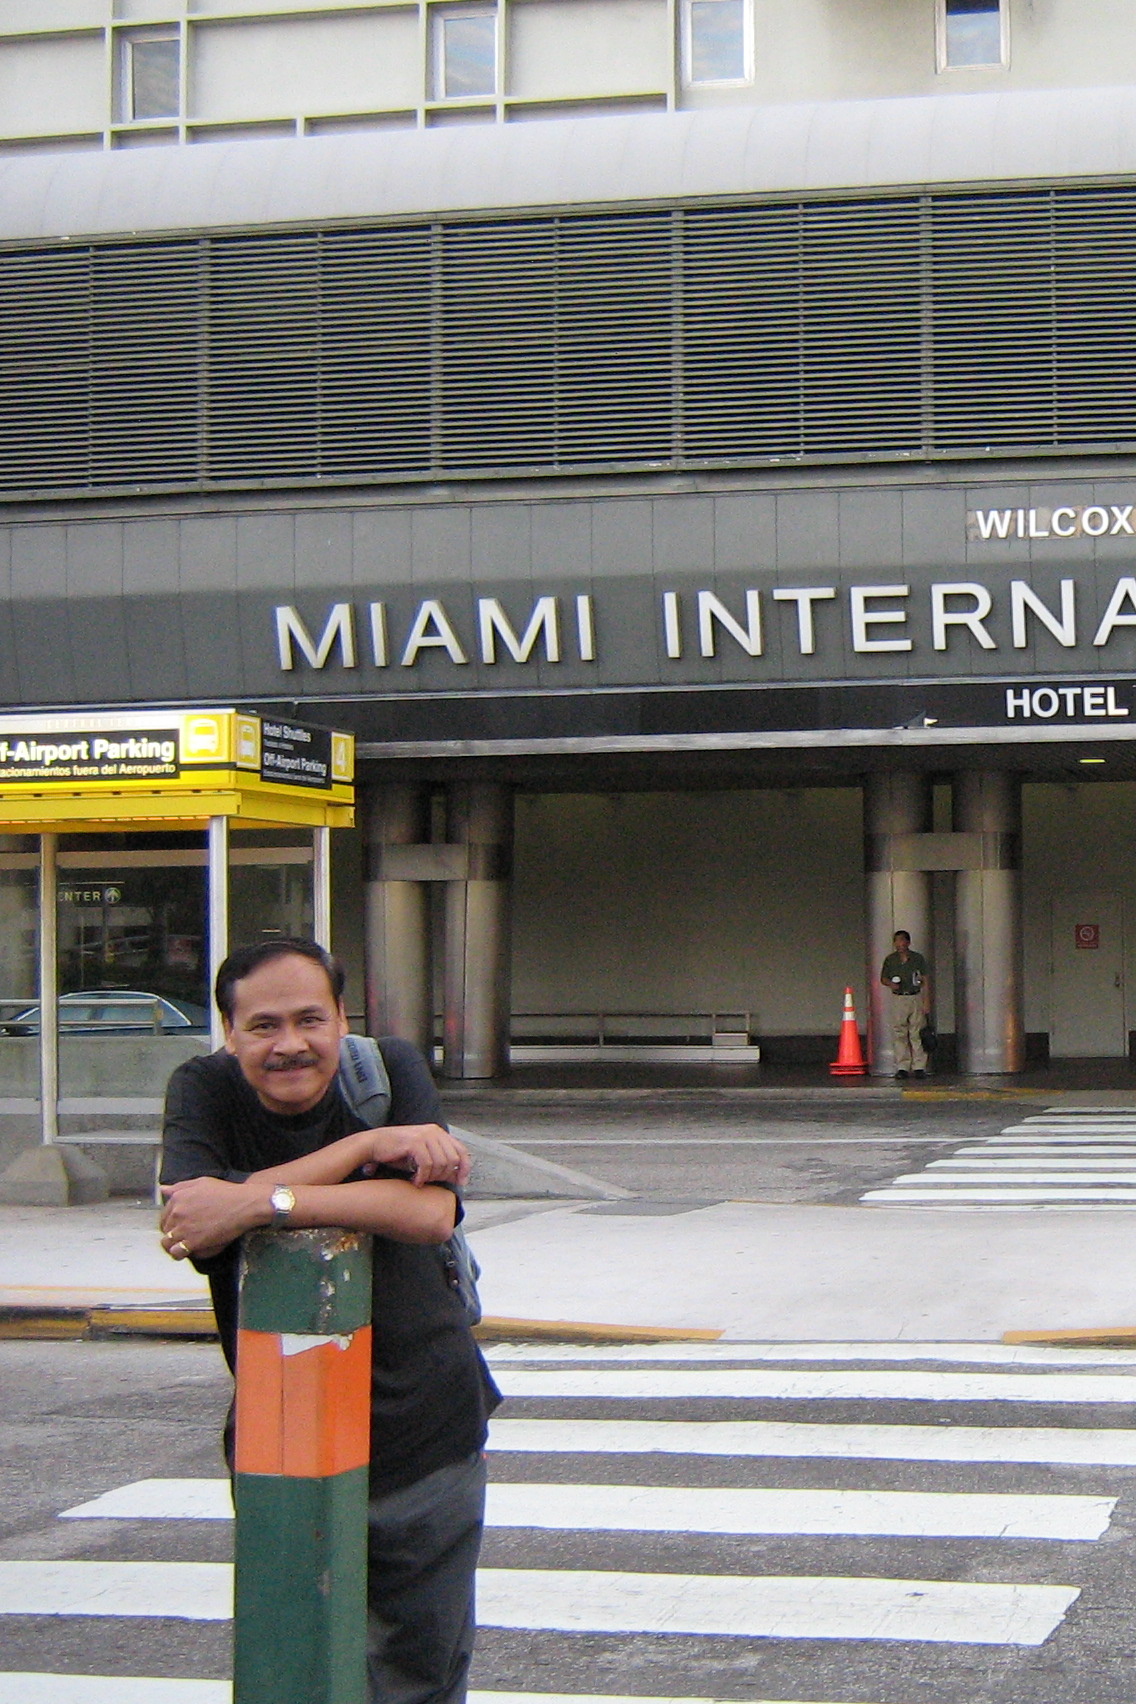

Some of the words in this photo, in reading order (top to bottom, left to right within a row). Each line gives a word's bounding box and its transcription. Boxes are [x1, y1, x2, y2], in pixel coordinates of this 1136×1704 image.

[976, 505, 1135, 539] WILCOX
[275, 594, 596, 671] MIAMI
[1005, 686, 1129, 718] HOTEL
[94, 737, 175, 763] Parking
[73, 765, 99, 776] fuera
[101, 764, 117, 775] del
[119, 762, 177, 777] Aeropuerto
[301, 758, 328, 777] Parking
